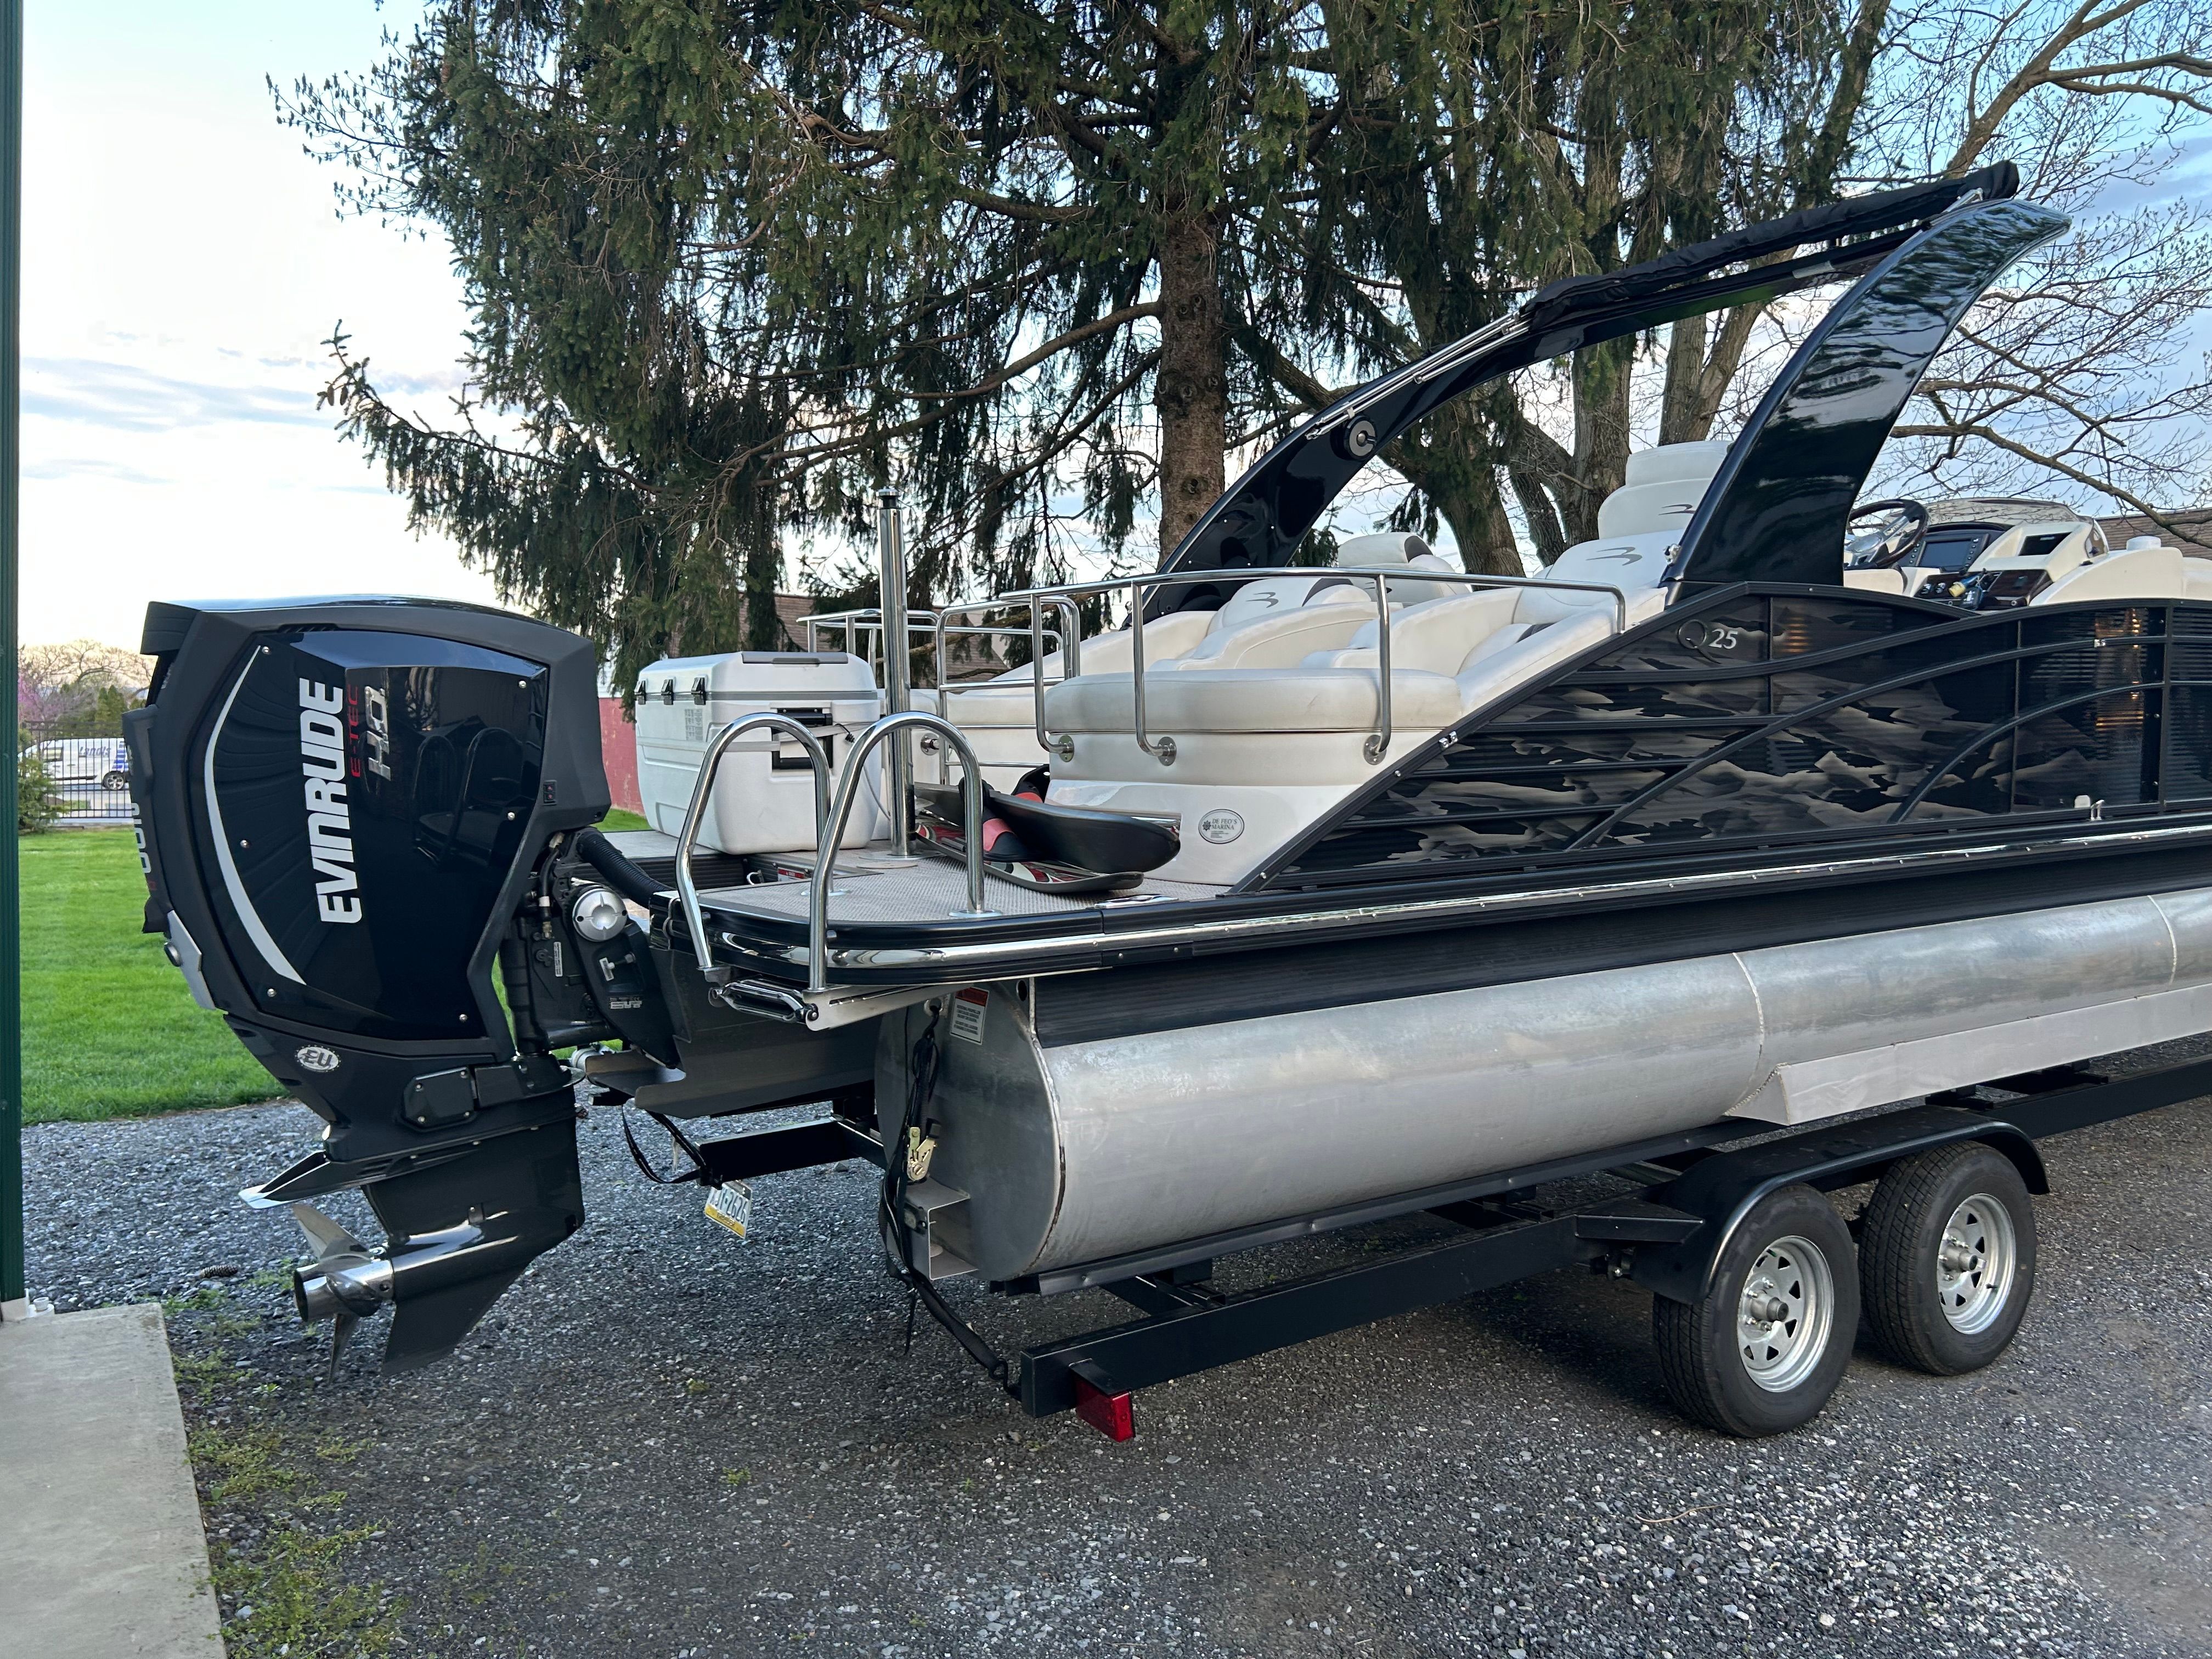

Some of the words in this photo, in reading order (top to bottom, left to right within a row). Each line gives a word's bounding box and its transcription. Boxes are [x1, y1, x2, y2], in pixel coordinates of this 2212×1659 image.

[1708, 628, 1738, 649] 25
[347, 685, 360, 777] E-TEC
[299, 678, 362, 923] EVINRUDE
